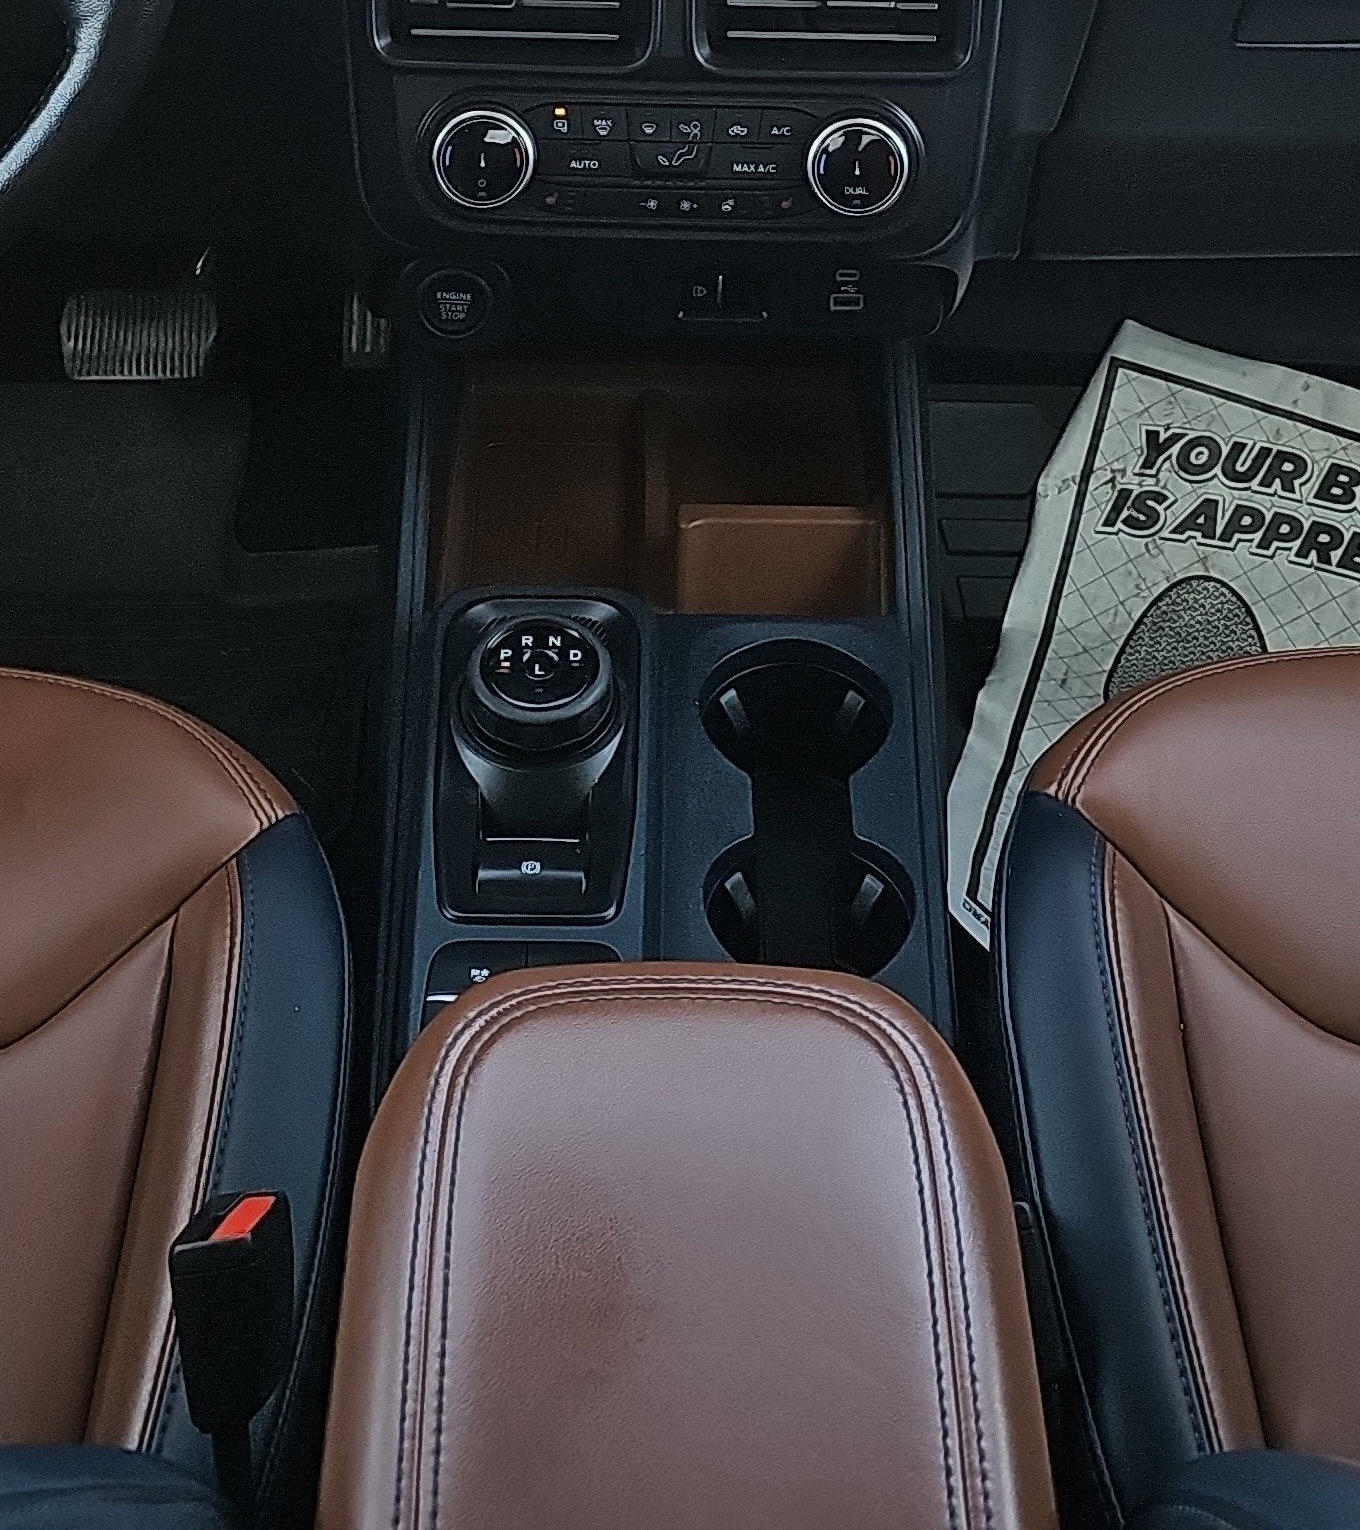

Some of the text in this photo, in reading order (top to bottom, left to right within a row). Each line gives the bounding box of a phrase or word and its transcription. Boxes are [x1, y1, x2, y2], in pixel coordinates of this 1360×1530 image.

[593, 119, 613, 127] MAX
[770, 126, 791, 136] A/C
[569, 160, 599, 169] AUTO
[732, 163, 777, 173] MAX A/C
[844, 186, 869, 195] DUAL
[436, 291, 473, 301] ENGINE
[439, 304, 469, 312] START
[441, 312, 467, 320] STOP
[1136, 427, 1313, 499] YOUR
[1098, 485, 1168, 544] IS
[521, 635, 561, 647] R N
[500, 649, 513, 660] P
[569, 650, 582, 661] D
[534, 663, 546, 675] L
